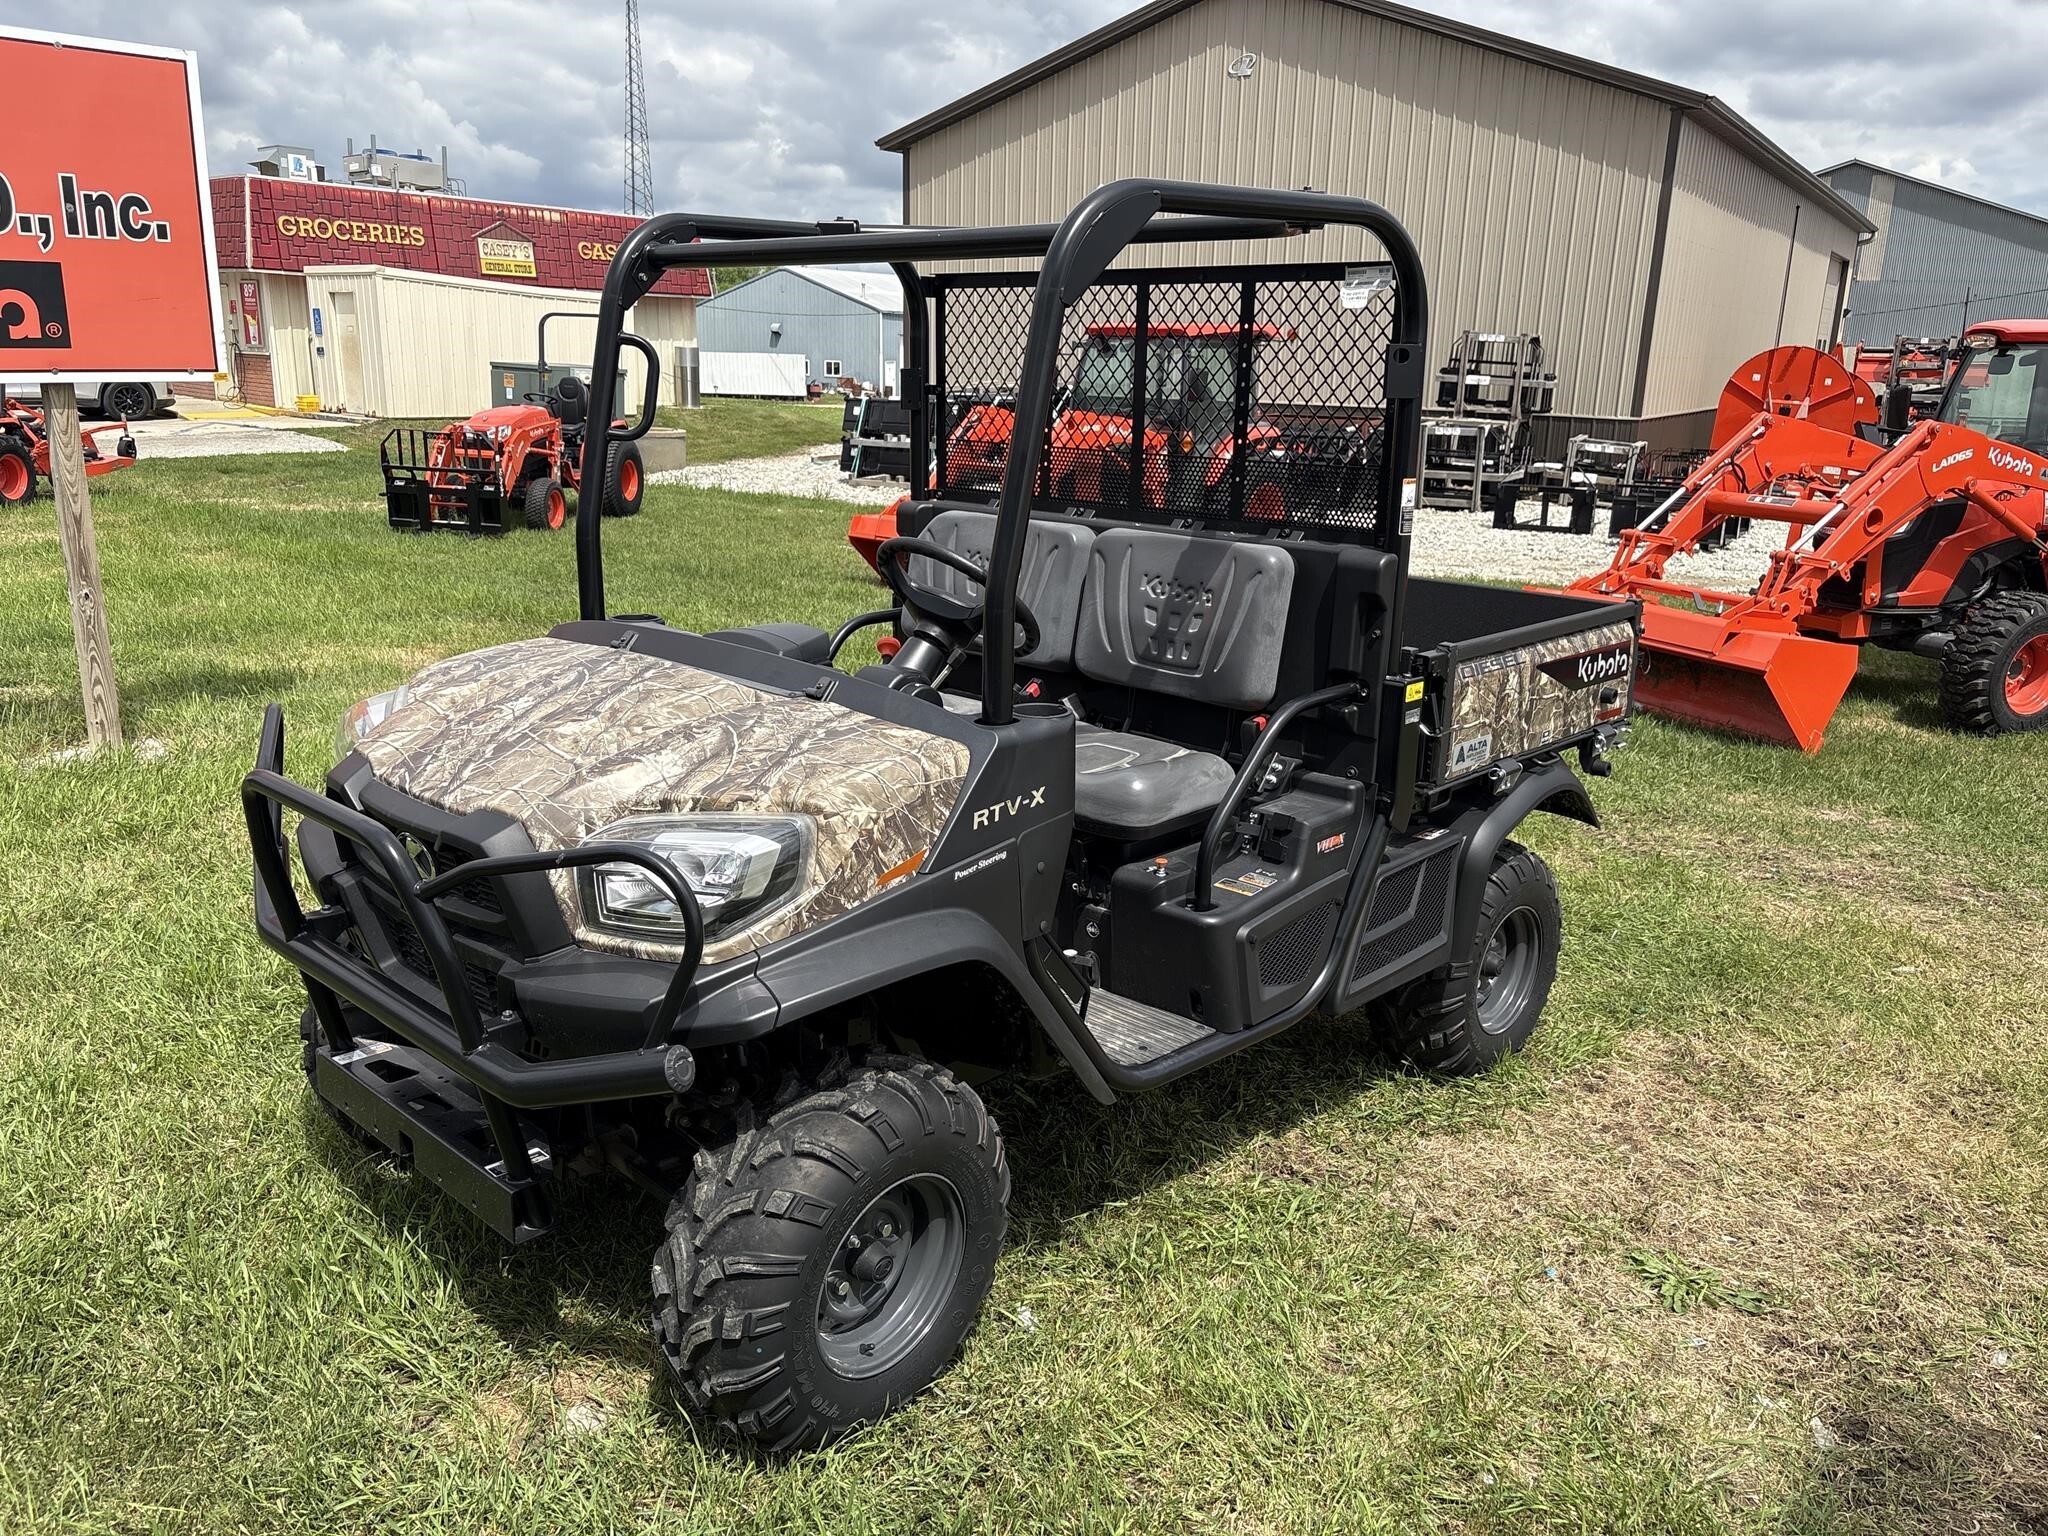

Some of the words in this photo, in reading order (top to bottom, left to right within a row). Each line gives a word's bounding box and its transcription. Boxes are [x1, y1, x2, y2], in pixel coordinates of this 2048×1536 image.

[58, 174, 171, 242] Inc.
[277, 215, 425, 246] GROCERIES
[482, 243, 531, 259] CASEY'S
[578, 241, 617, 261] GAS
[485, 262, 513, 273] GENERAL
[514, 264, 533, 275] STORE
[1932, 448, 1974, 473] LA1065
[1987, 446, 2034, 477] Kubota
[1140, 573, 1213, 607] Kubota
[1459, 650, 1527, 680] DIESEL
[1578, 648, 1628, 683] Kubota
[1467, 739, 1488, 753] ALTA
[973, 785, 1046, 831] RTV-X
[954, 864, 977, 880] Power
[978, 850, 1007, 869] Steering
